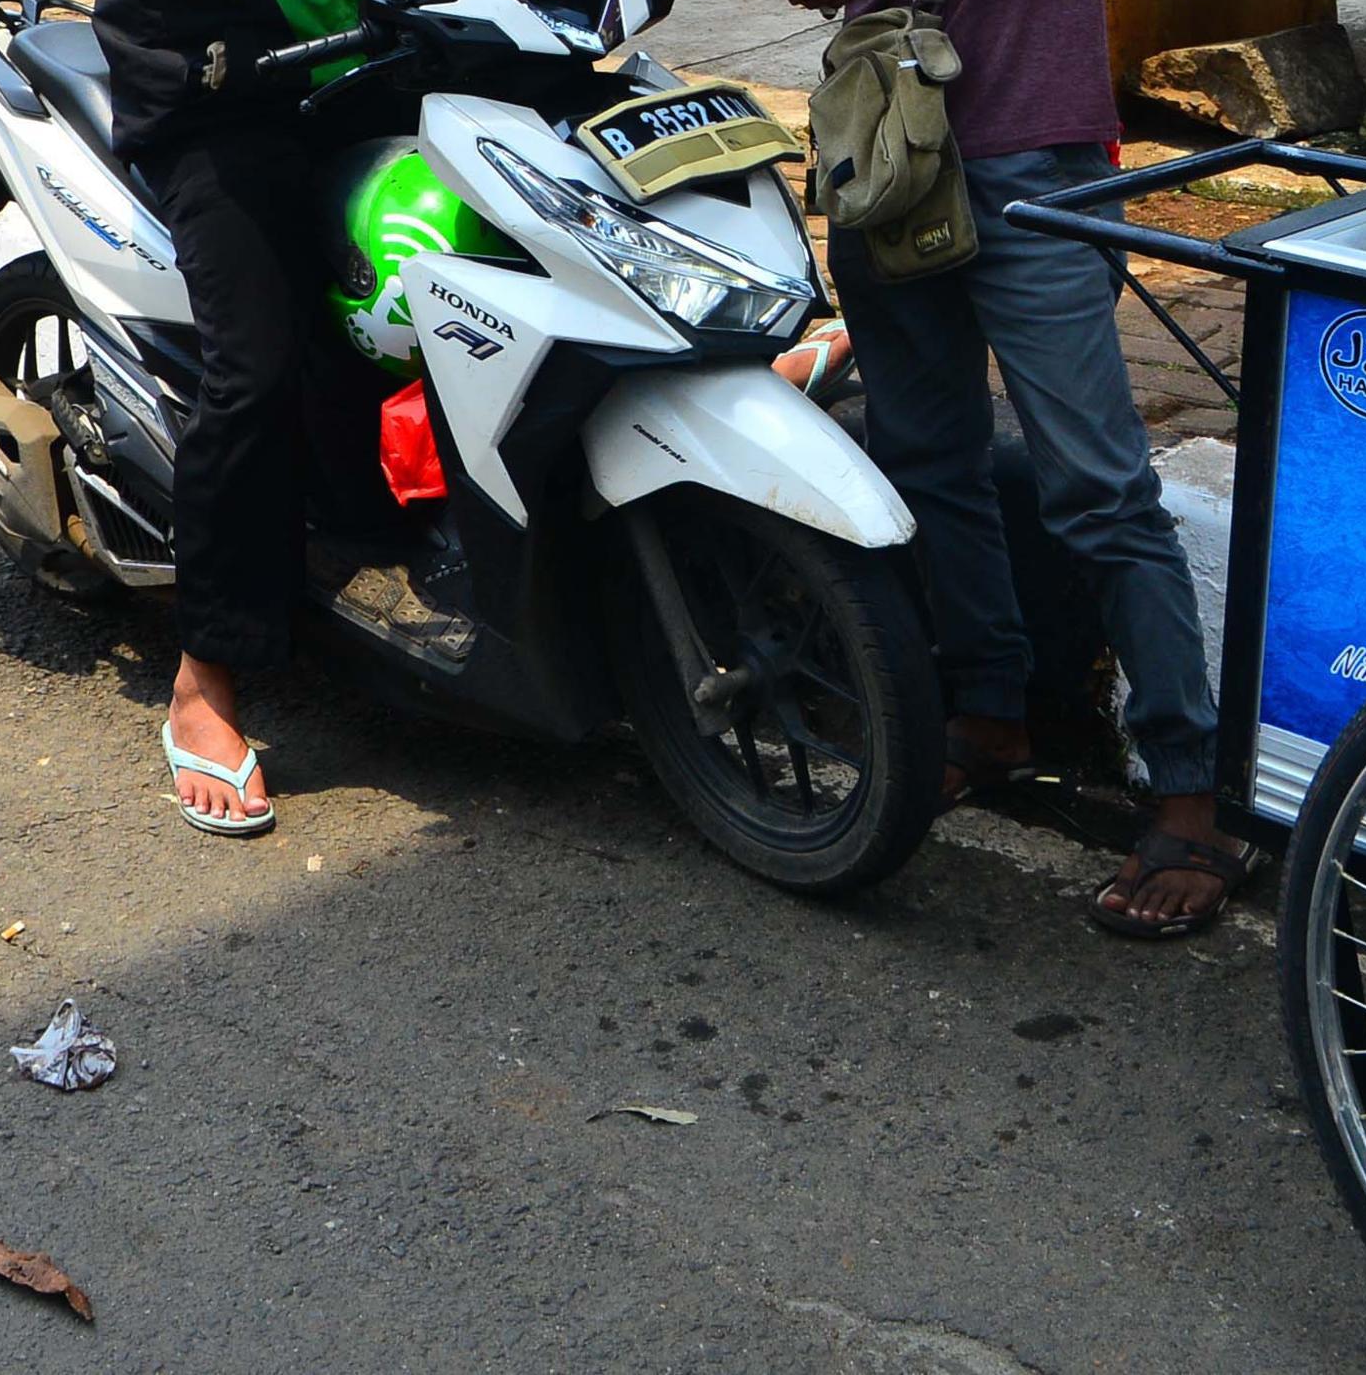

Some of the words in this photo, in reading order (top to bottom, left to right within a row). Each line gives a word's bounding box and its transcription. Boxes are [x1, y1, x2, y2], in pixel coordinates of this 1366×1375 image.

[600, 127, 635, 159] B
[640, 101, 717, 139] 3552
[129, 242, 167, 271] 150
[429, 280, 516, 342] HONDA
